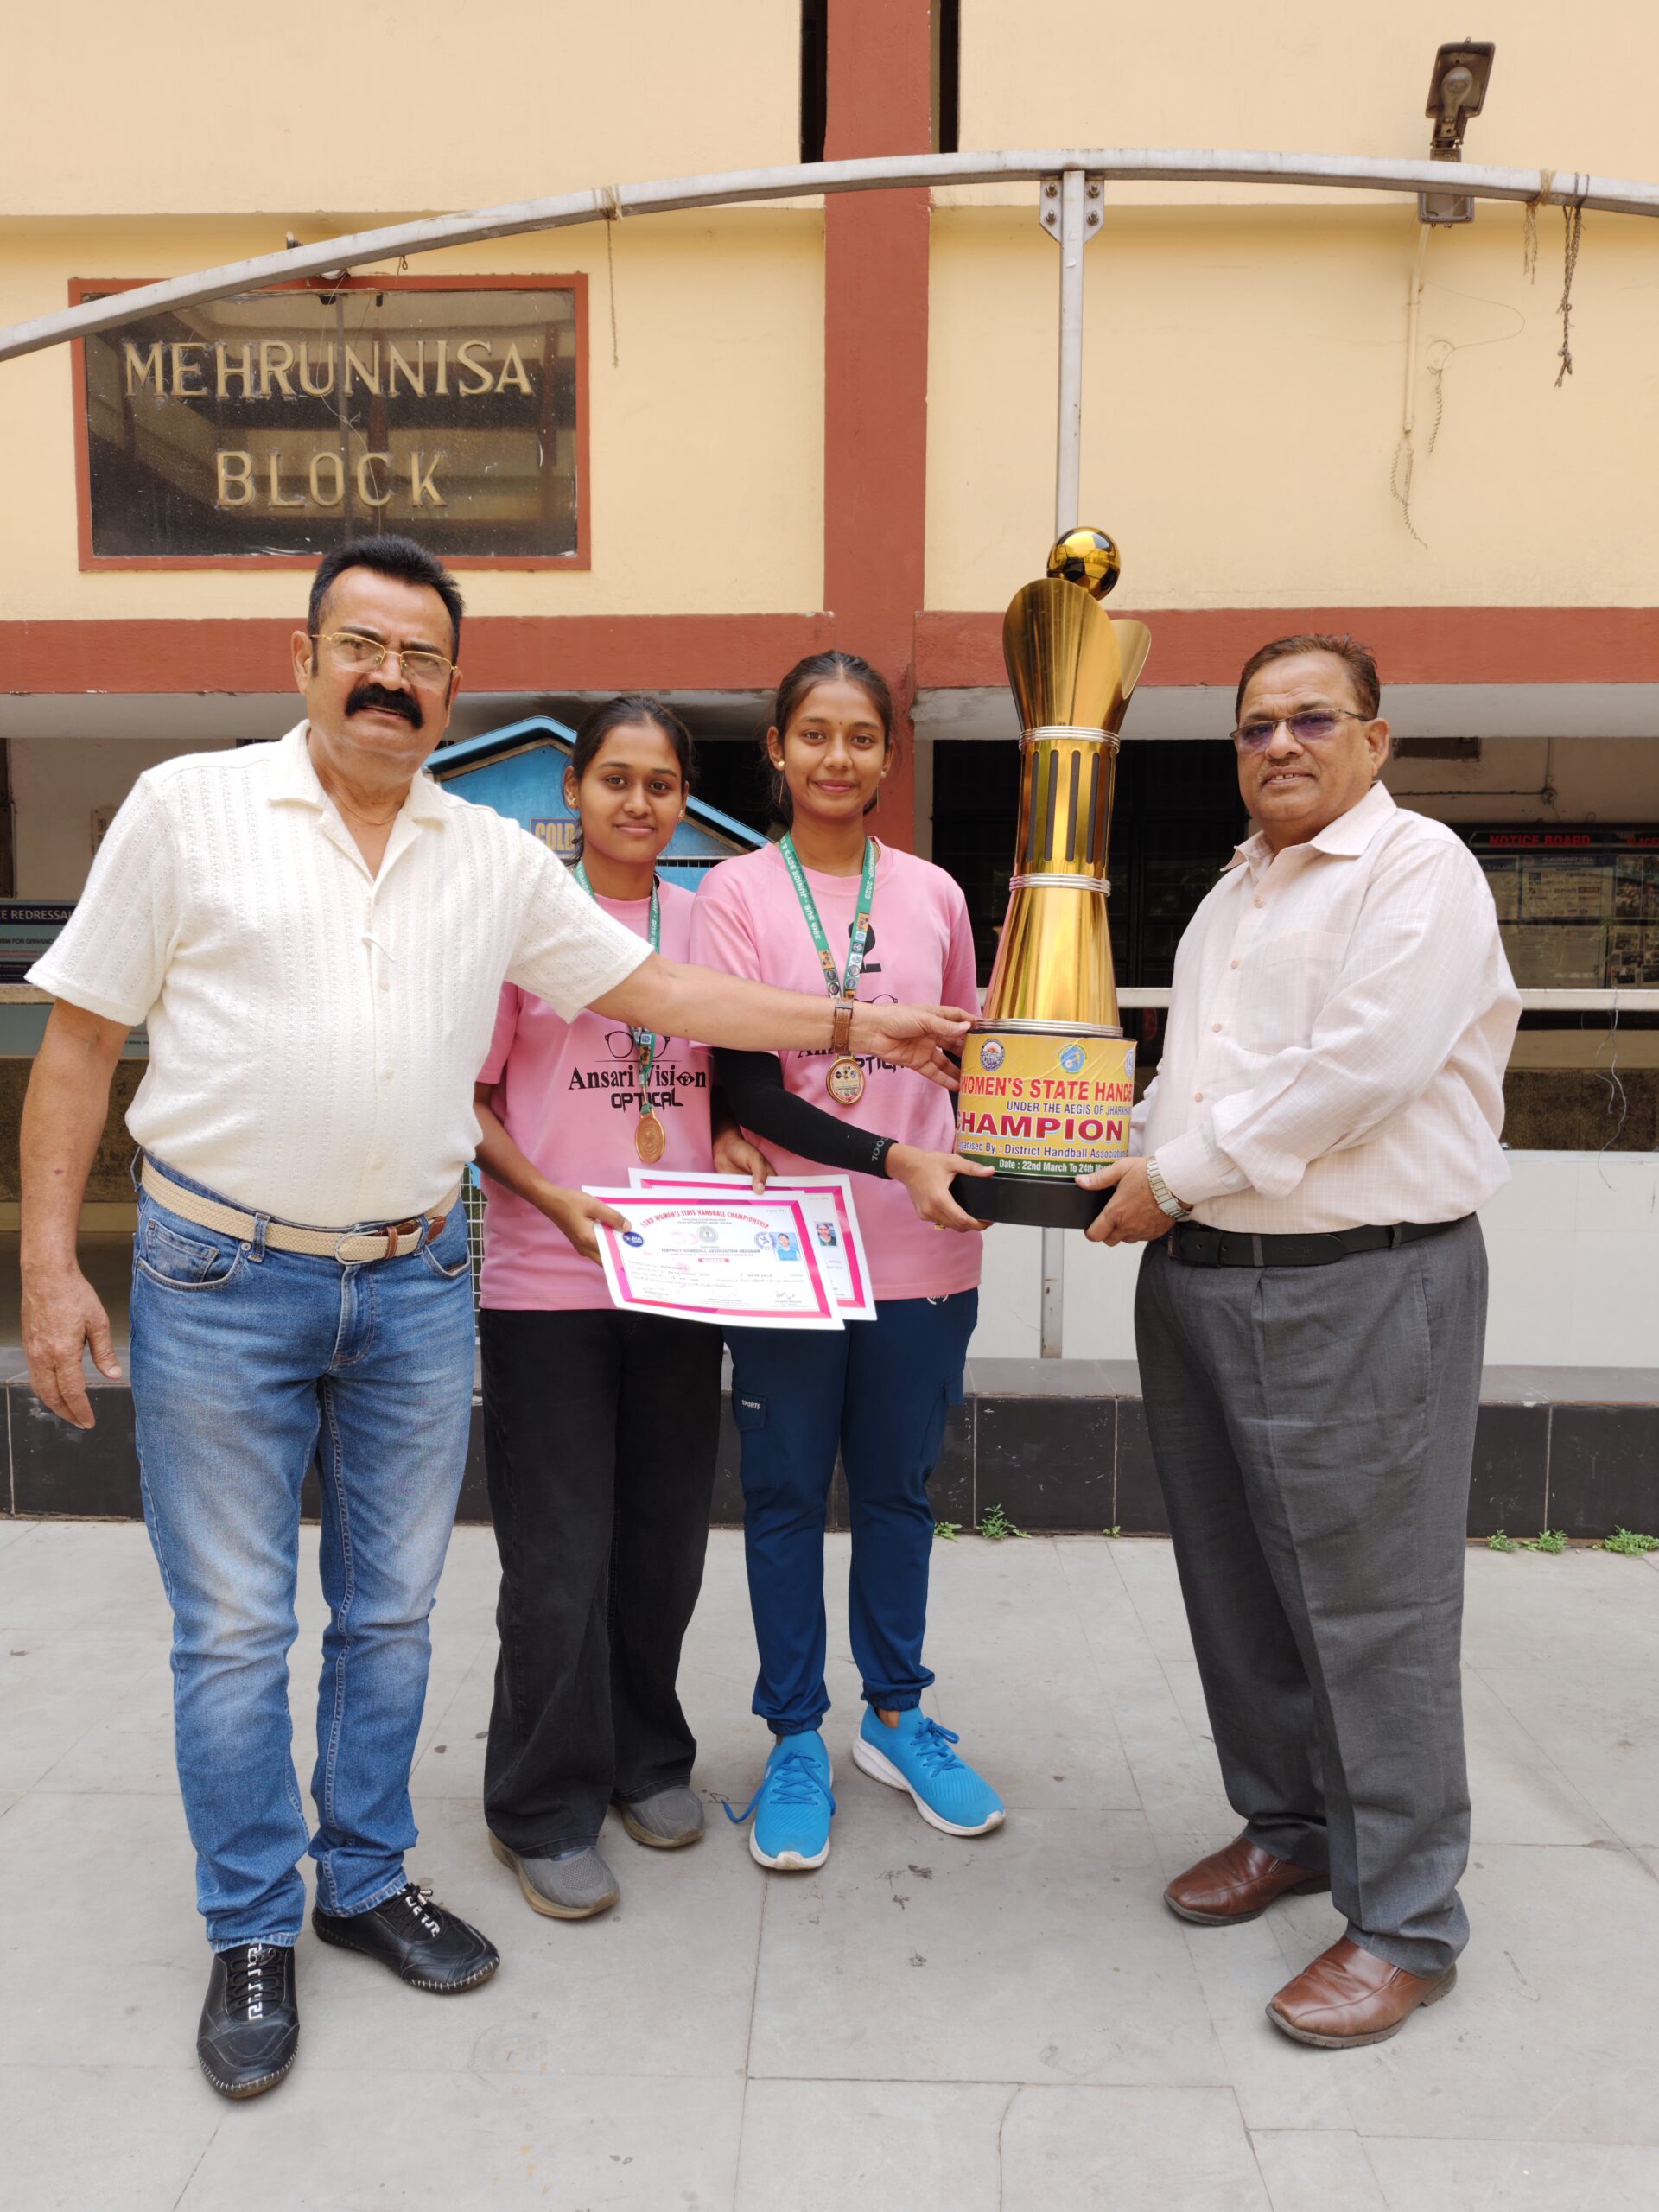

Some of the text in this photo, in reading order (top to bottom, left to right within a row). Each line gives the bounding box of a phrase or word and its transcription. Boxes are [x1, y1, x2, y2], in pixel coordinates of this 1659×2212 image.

[125, 340, 534, 398] MEHRUNNISA
[216, 451, 448, 507] BLOCK
[535, 823, 575, 851] COLD
[1490, 835, 1591, 847] NOTICE BOARD
[791, 869, 807, 898] JUNIOR
[864, 880, 873, 899] 2025
[804, 904, 815, 921] SUB
[569, 1065, 634, 1090] Ansari
[962, 1075, 1023, 1097] WOMEN'S
[1029, 1078, 1090, 1100] STATE
[611, 1088, 683, 1113] OPTICAL
[1007, 1101, 1039, 1112] UNDER
[1043, 1103, 1061, 1114] THE
[1064, 1104, 1091, 1115] AEGIS
[1094, 1105, 1104, 1115] OF
[986, 1142, 996, 1154] By
[1005, 1144, 1040, 1156] District
[1044, 1147, 1087, 1158] Handball
[999, 1159, 1015, 1169] Date
[1022, 1161, 1041, 1171] 22nd
[1043, 1162, 1067, 1172] March
[1069, 1164, 1077, 1173] To
[1078, 1164, 1094, 1173] 24th
[639, 1217, 655, 1229] 53RD
[653, 1211, 680, 1222] WOMEN'S
[727, 1211, 770, 1229] CHAMPIONSHIP
[741, 1399, 760, 1409] SPORTS
